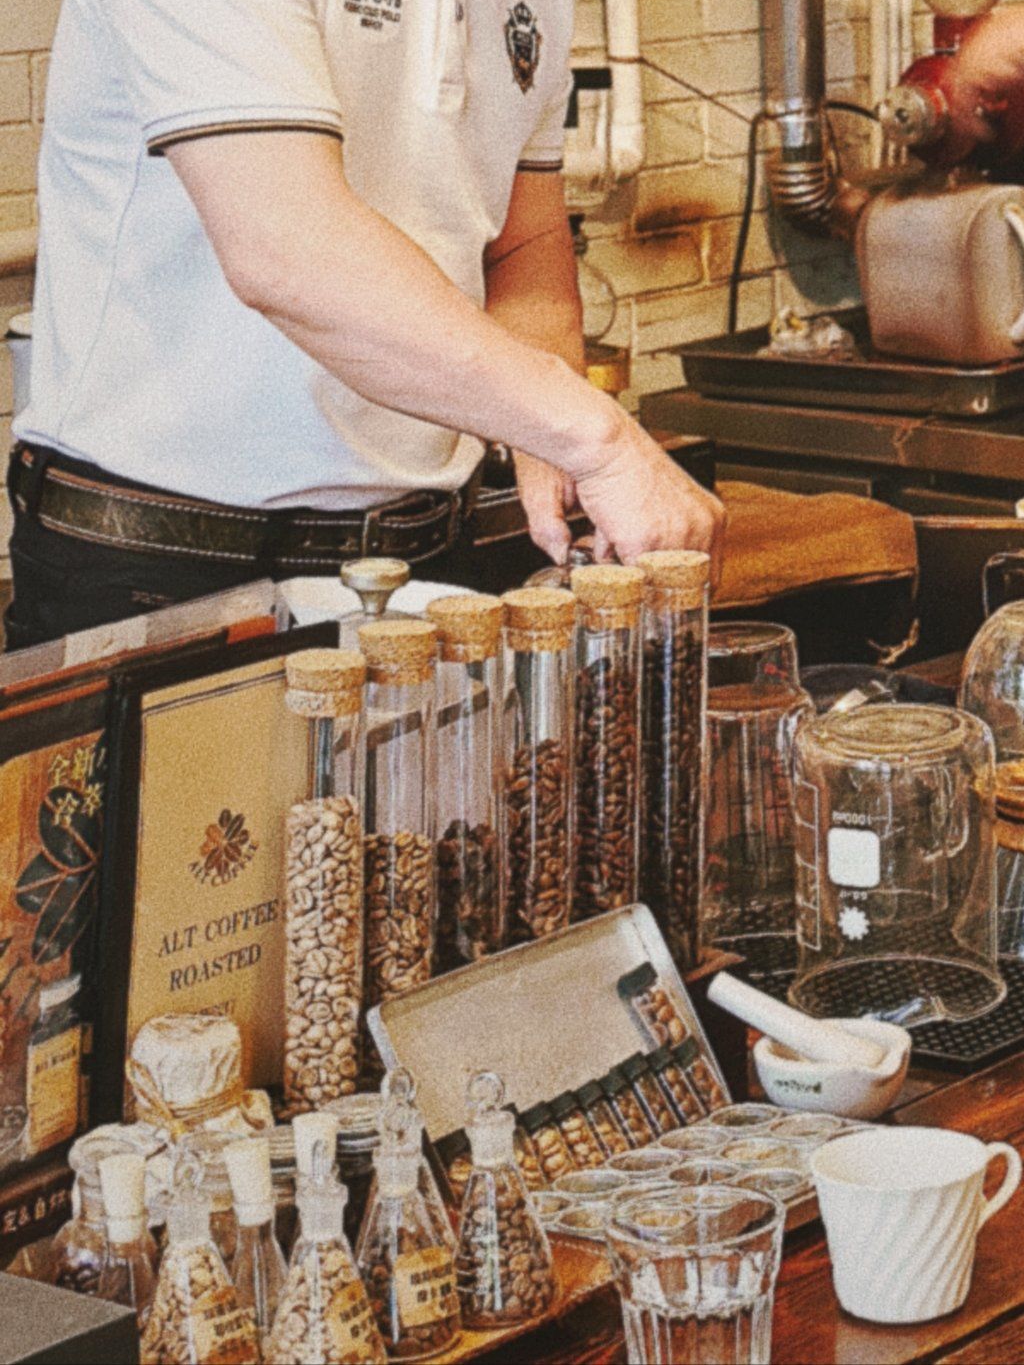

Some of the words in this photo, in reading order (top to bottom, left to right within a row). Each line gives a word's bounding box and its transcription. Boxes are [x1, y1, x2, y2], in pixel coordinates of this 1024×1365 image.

[157, 925, 198, 958] ALT
[204, 898, 280, 942] COFFEE
[169, 942, 262, 992] ROASTED
